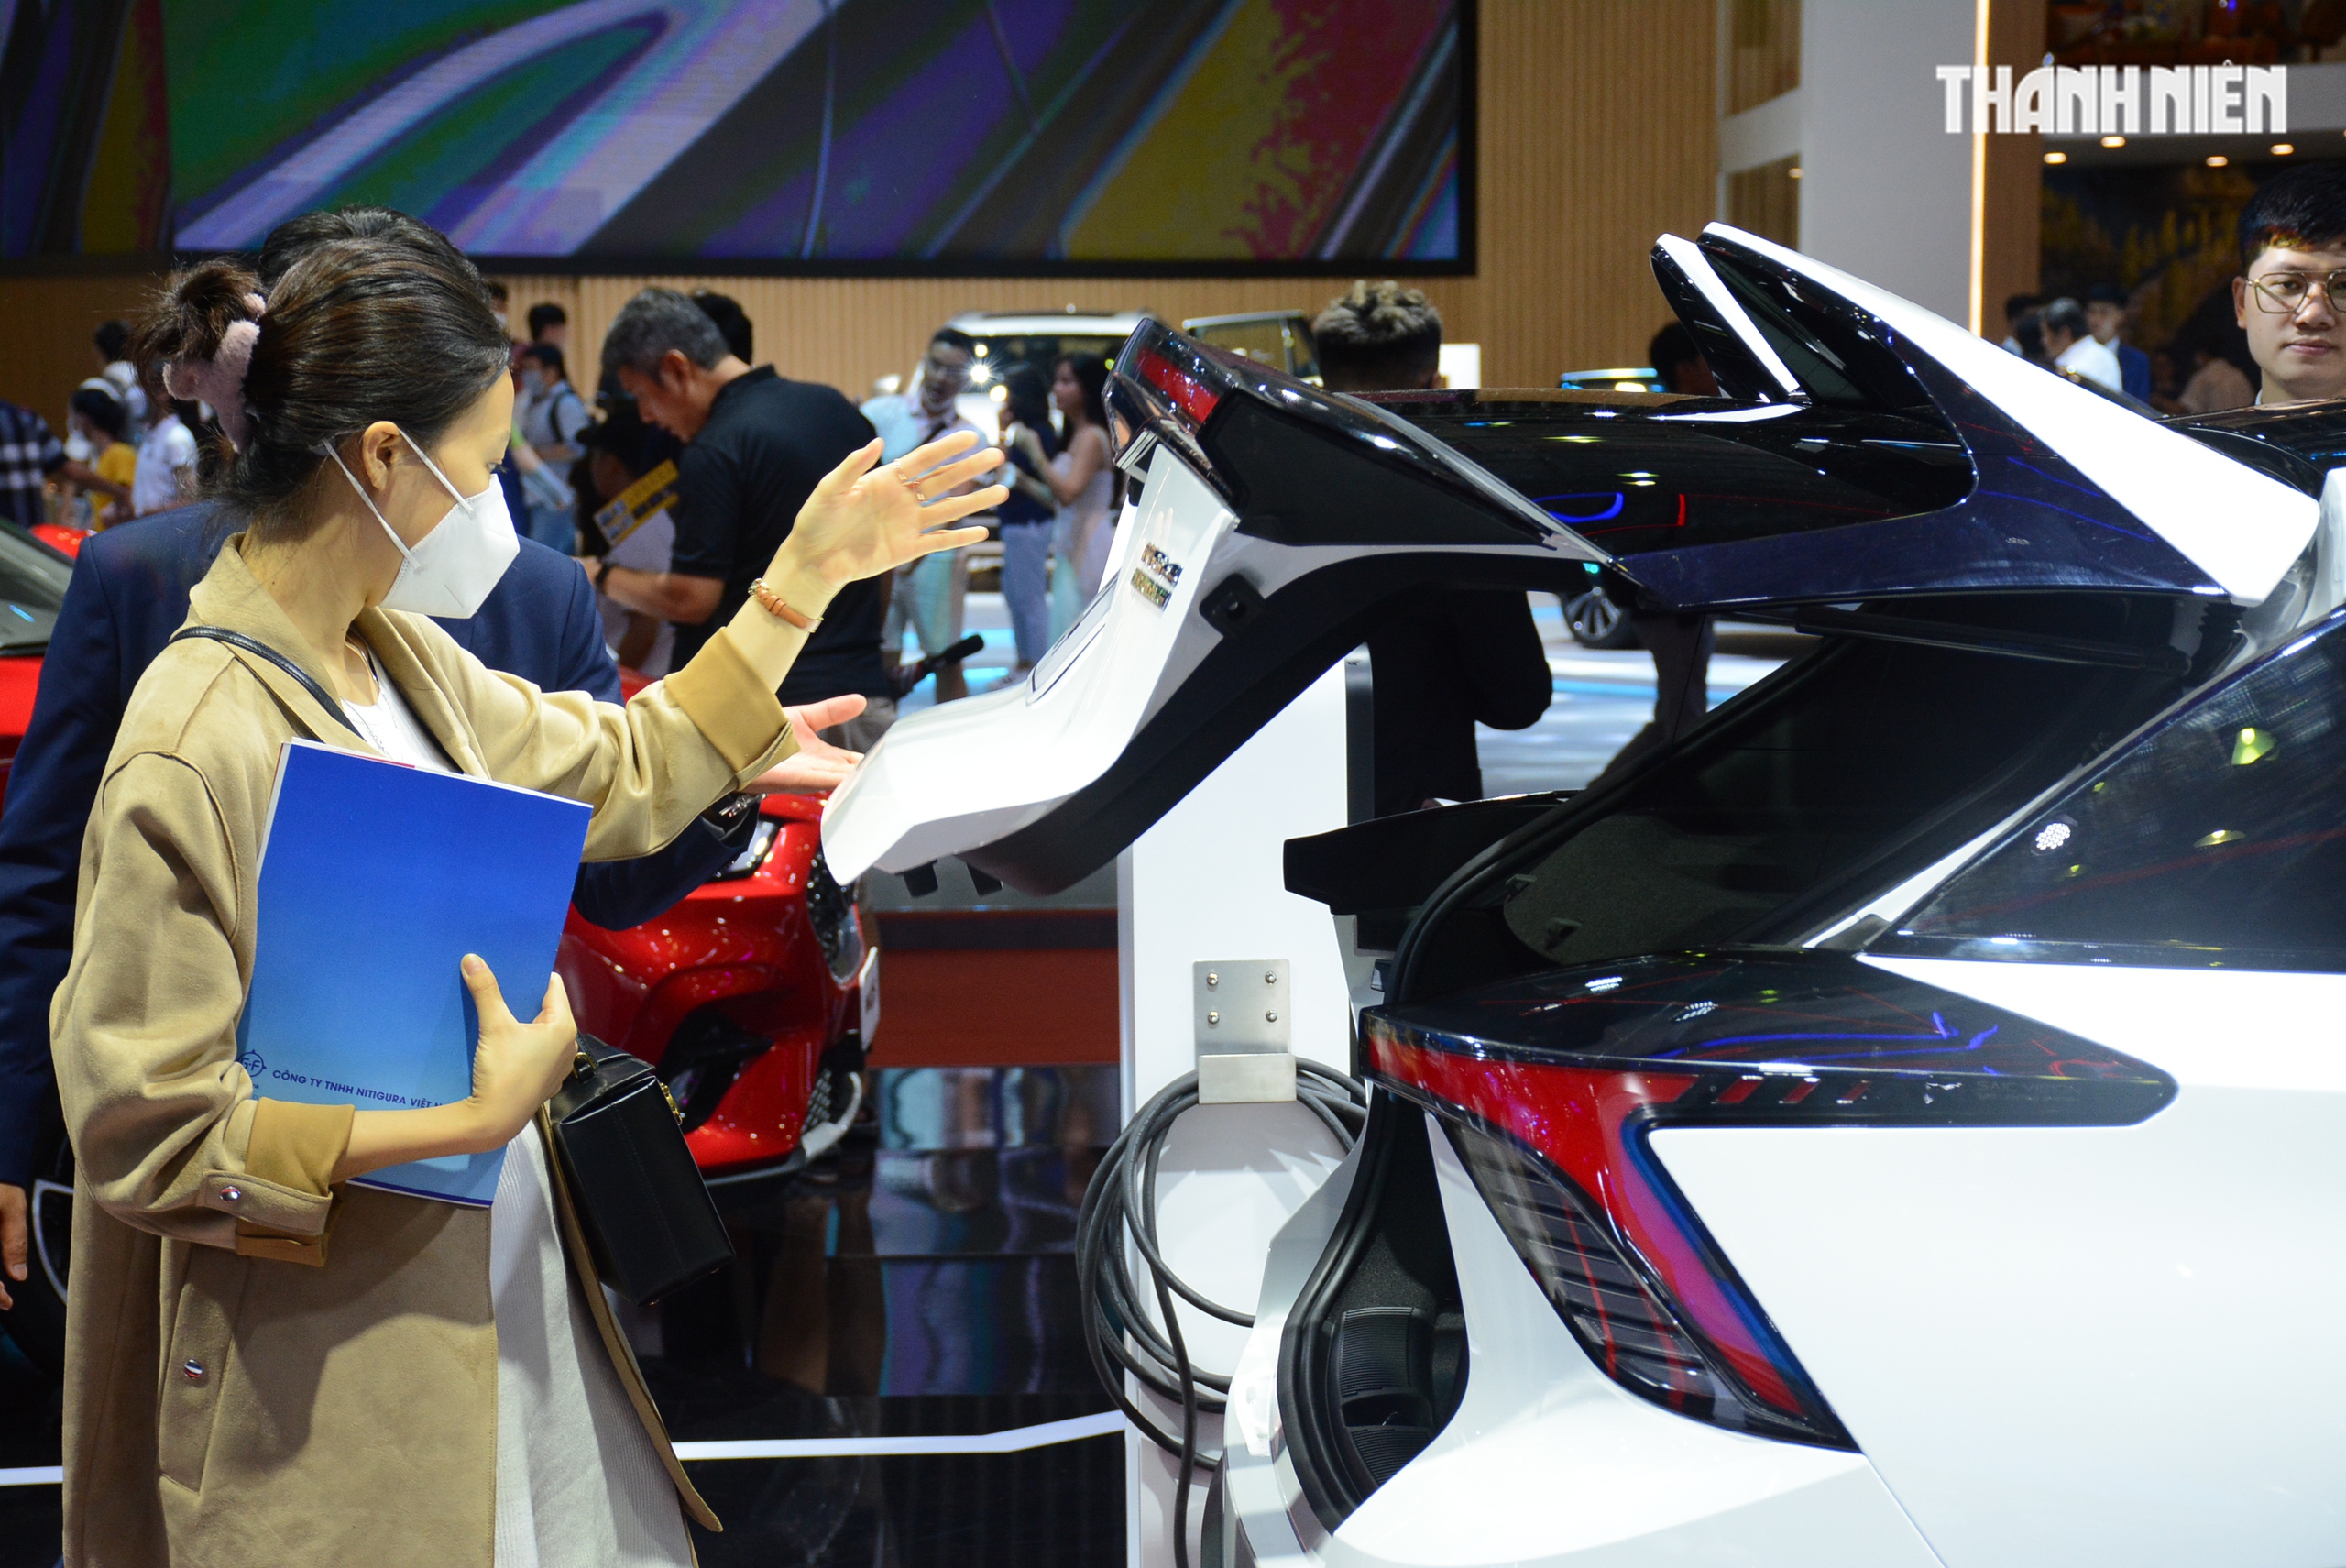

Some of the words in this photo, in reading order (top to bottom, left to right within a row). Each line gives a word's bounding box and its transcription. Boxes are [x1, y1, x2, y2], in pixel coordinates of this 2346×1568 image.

[272, 1069, 307, 1084] CÔNG
[310, 1077, 323, 1088] TY
[325, 1080, 355, 1095] TNHH
[356, 1087, 407, 1105] NITIGURA
